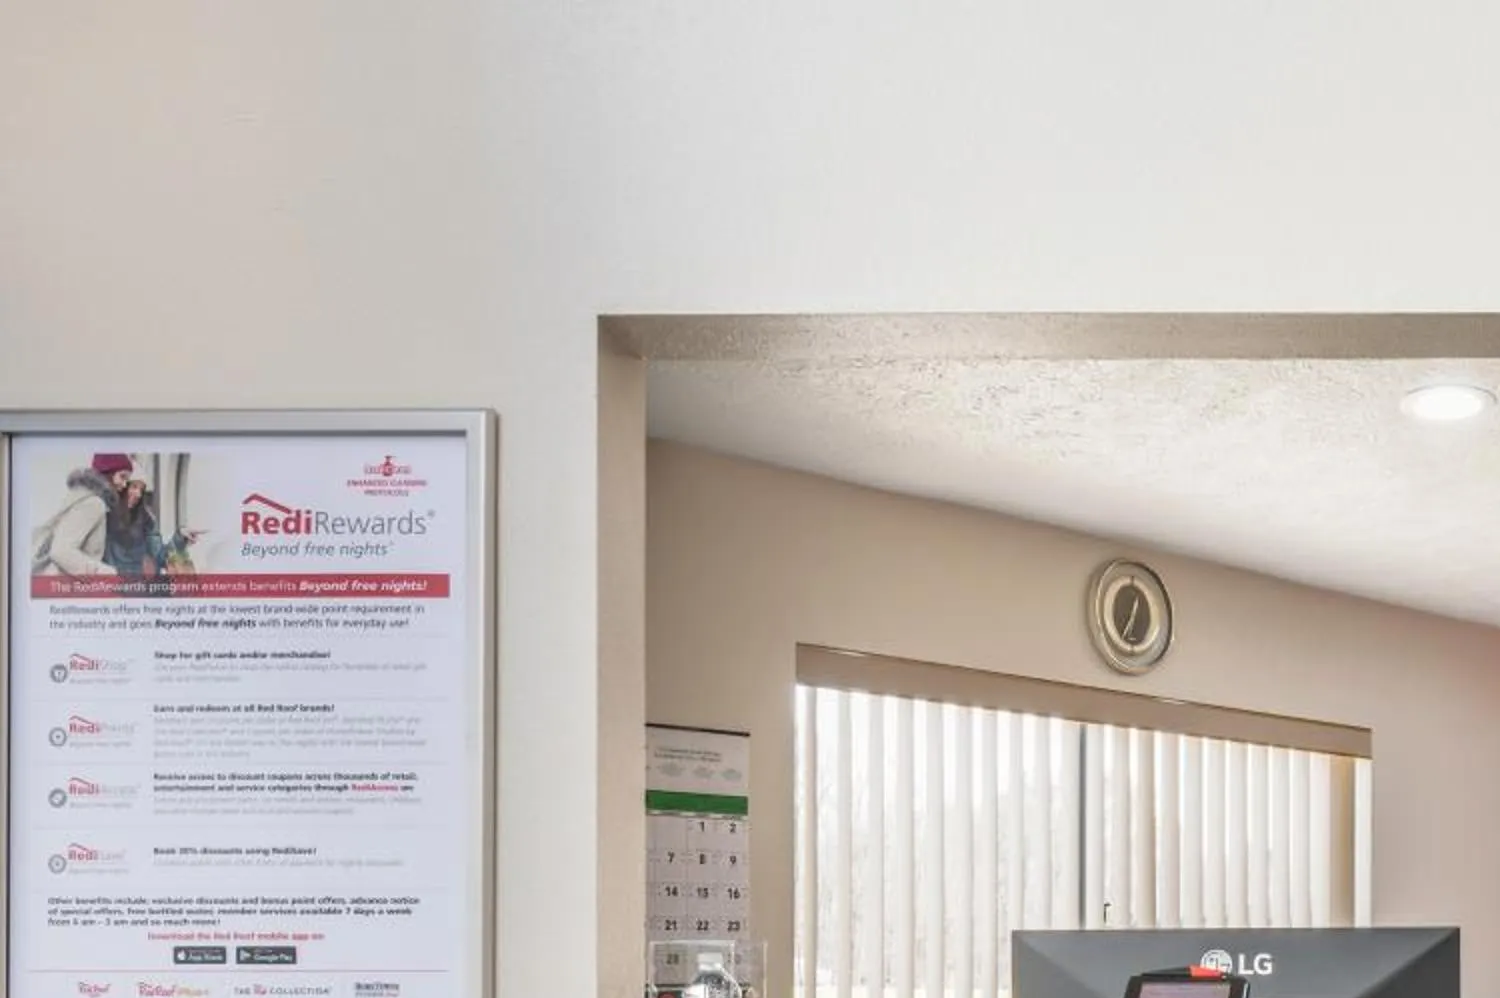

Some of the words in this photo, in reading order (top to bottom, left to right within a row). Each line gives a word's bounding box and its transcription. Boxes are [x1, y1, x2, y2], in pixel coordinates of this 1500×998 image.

[241, 543, 300, 559] Beyond
[303, 543, 335, 557] free
[339, 543, 388, 559] nights
[699, 821, 705, 832] 1
[729, 823, 737, 833] 2
[667, 852, 675, 864] 7
[729, 855, 737, 865] 9
[665, 886, 679, 898] 14
[696, 886, 709, 898] 15
[727, 888, 741, 900] 16
[664, 919, 678, 931] 21
[696, 920, 709, 932] 22
[727, 920, 741, 932] 23
[1237, 952, 1274, 975] LG
